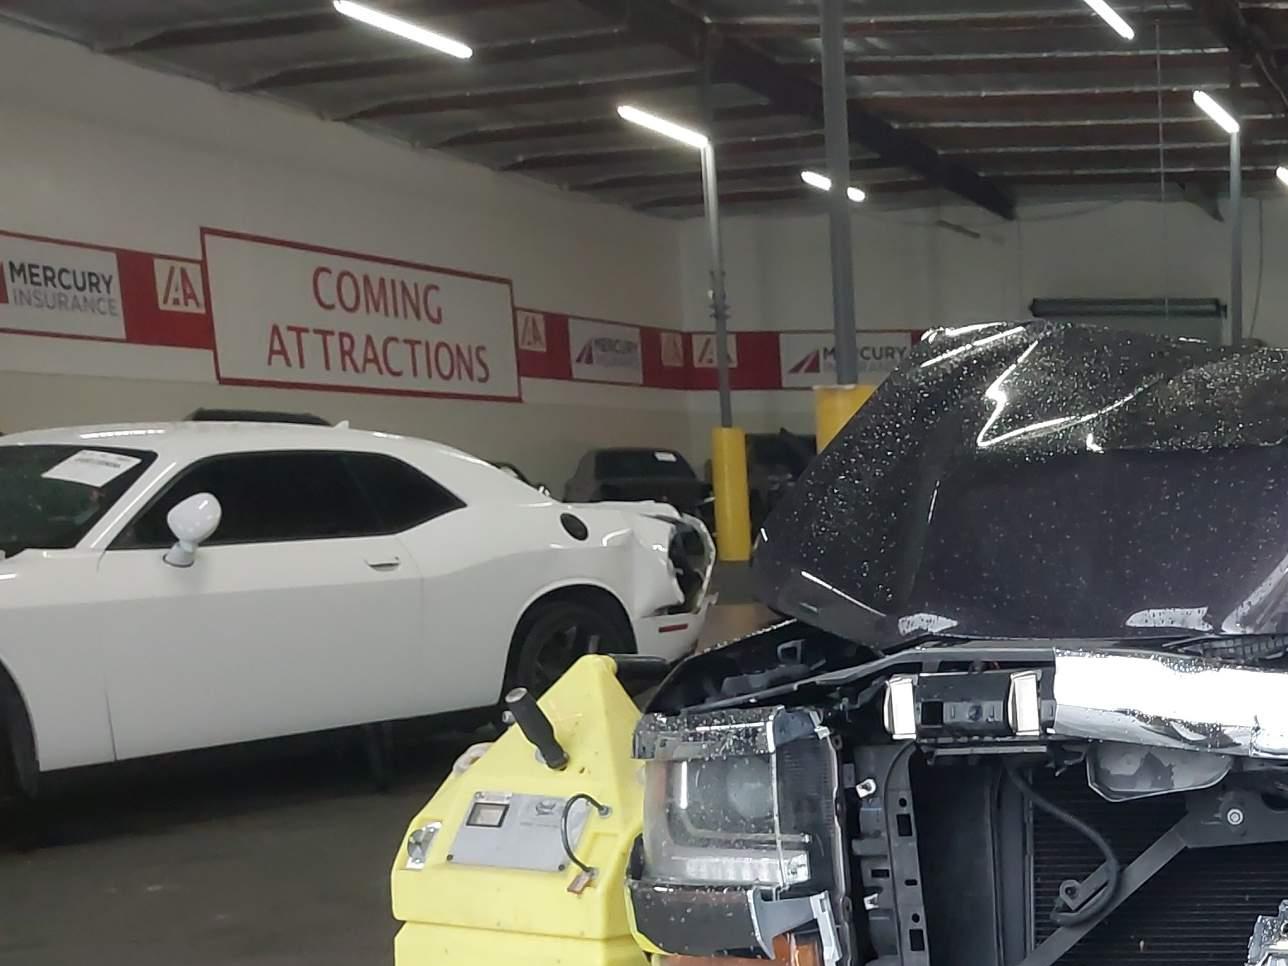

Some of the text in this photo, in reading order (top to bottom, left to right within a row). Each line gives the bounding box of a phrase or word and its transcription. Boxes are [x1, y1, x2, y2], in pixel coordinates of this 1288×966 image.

[8, 261, 113, 294] MERCURY
[13, 288, 119, 316] INSURANCE
[312, 267, 443, 324] COMING
[267, 324, 489, 383] ATTRACTIONS
[824, 347, 907, 361] MCURY
